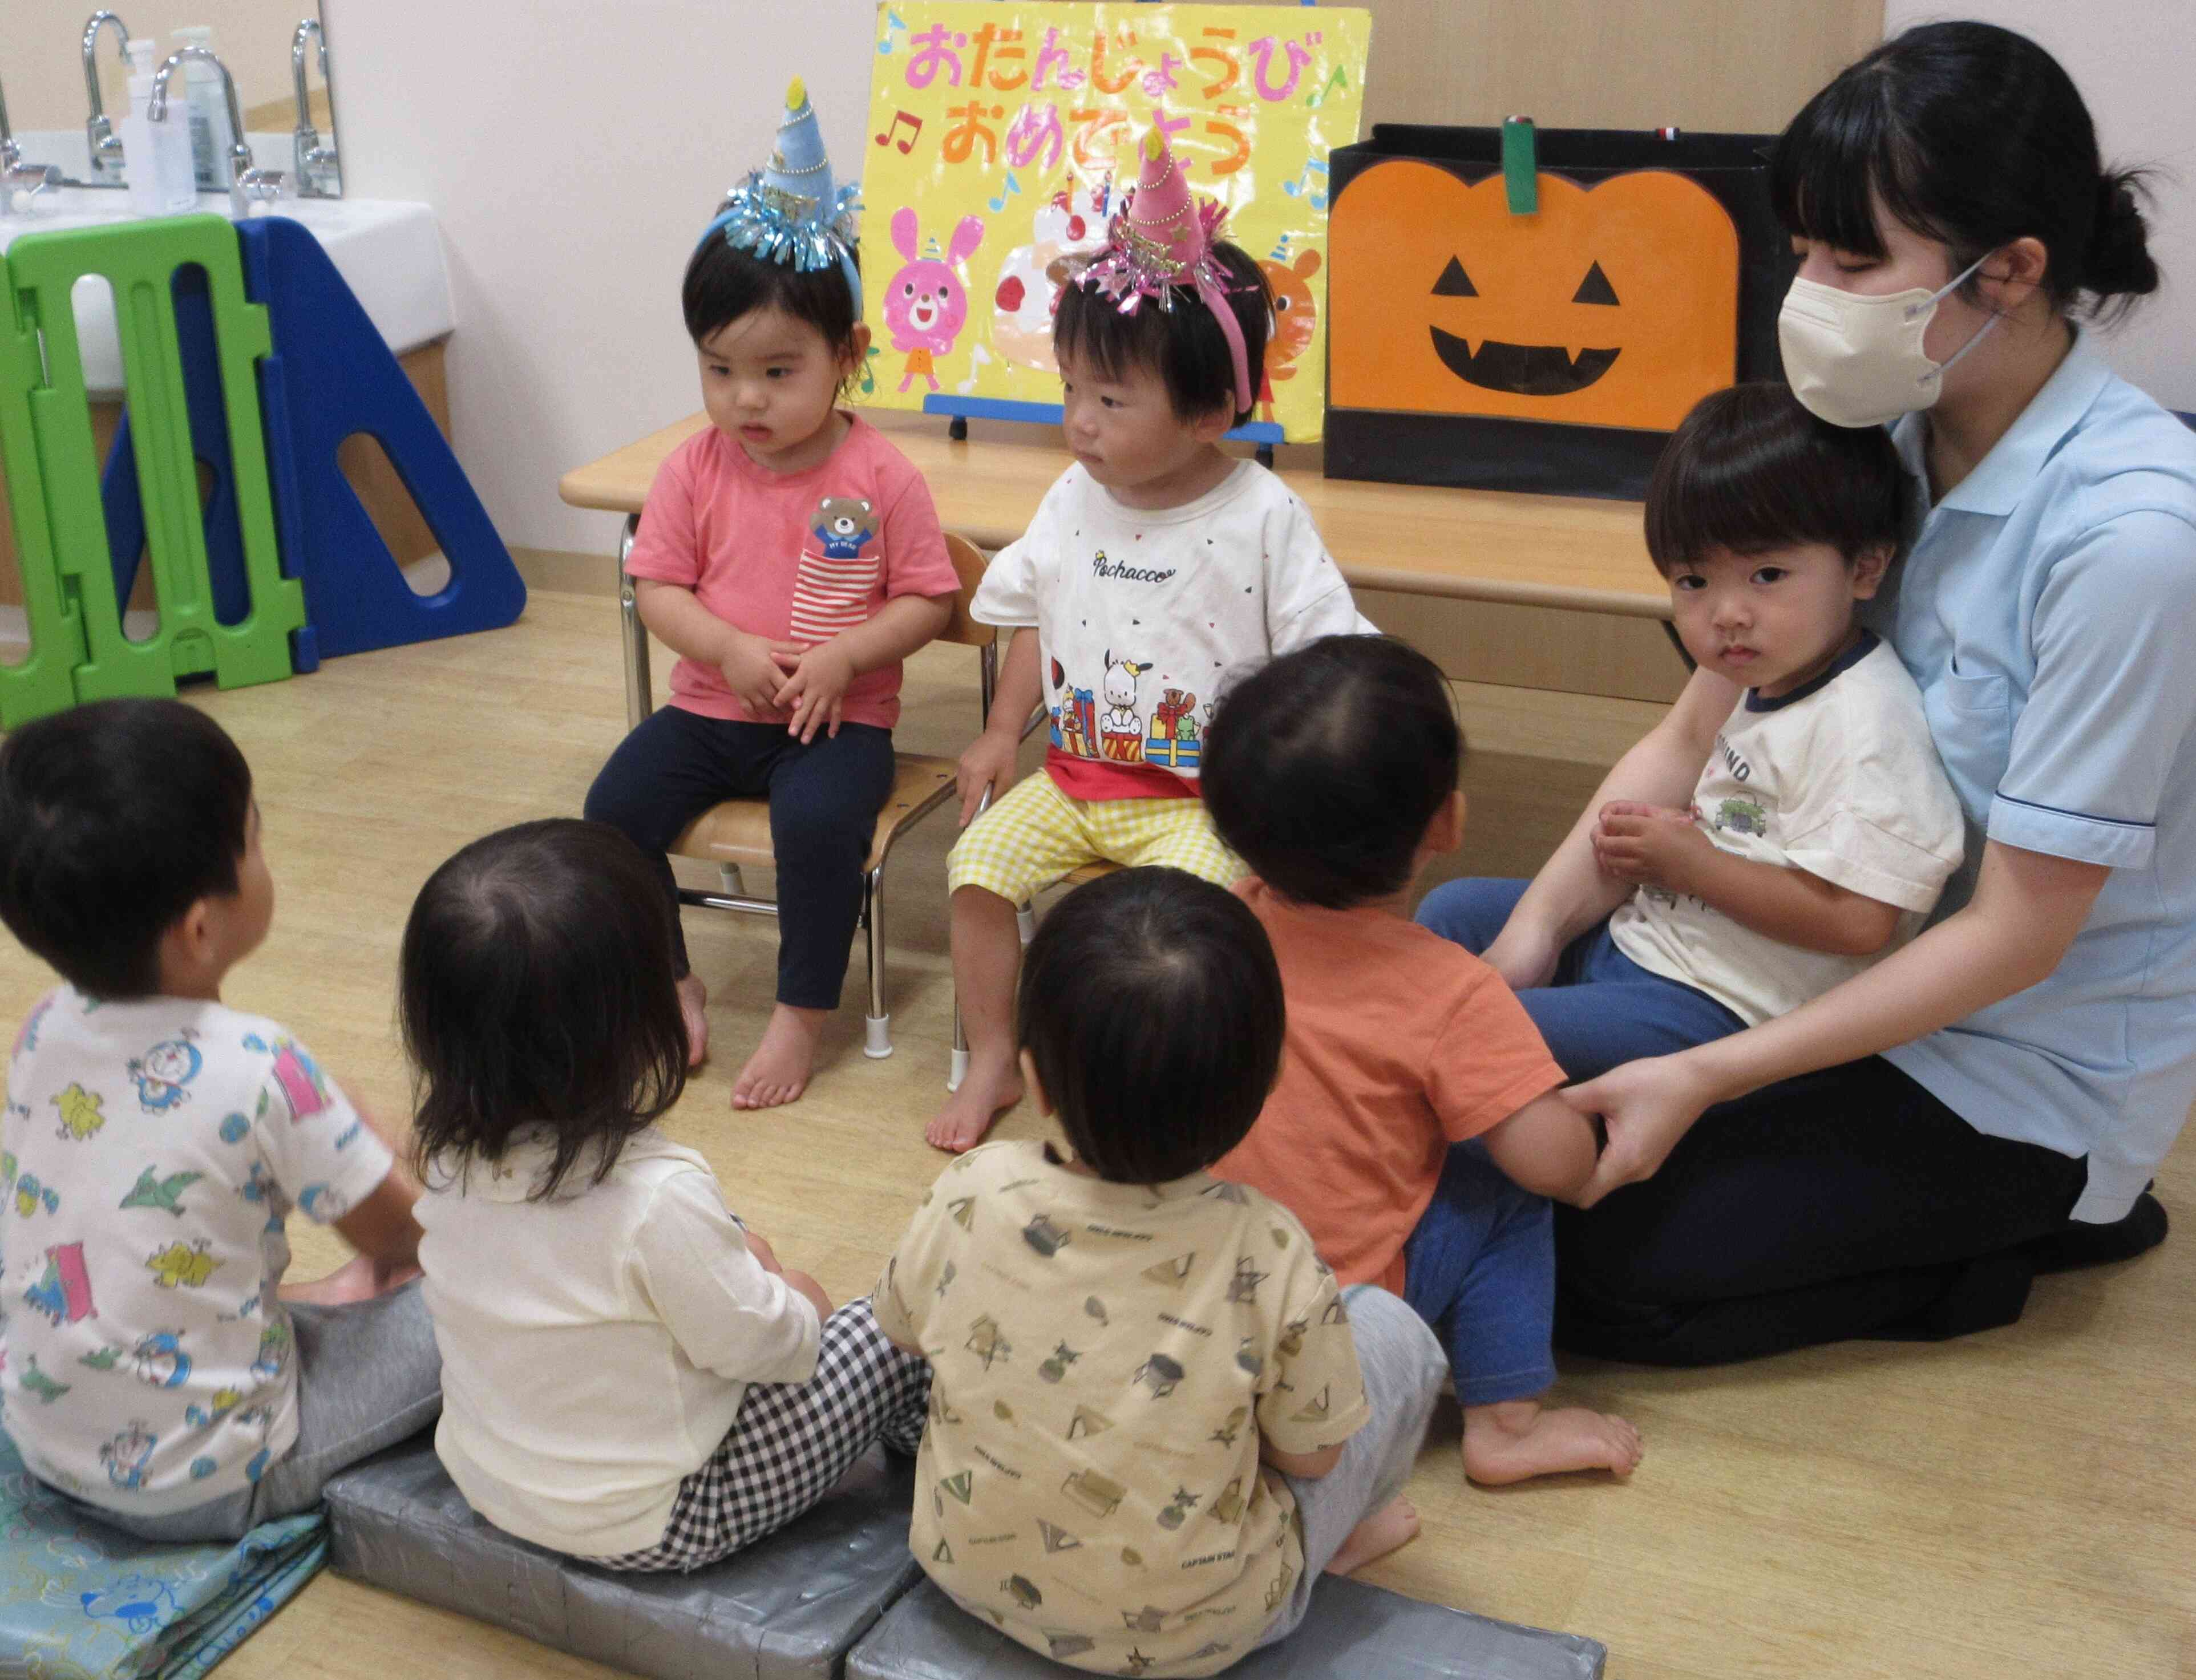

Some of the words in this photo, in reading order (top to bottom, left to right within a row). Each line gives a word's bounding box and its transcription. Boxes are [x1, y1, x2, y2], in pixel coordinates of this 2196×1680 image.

[905, 22, 1322, 102] おたんじょうび
[941, 100, 1251, 176] おめでとう
[1093, 555, 1176, 583] Pochacco
